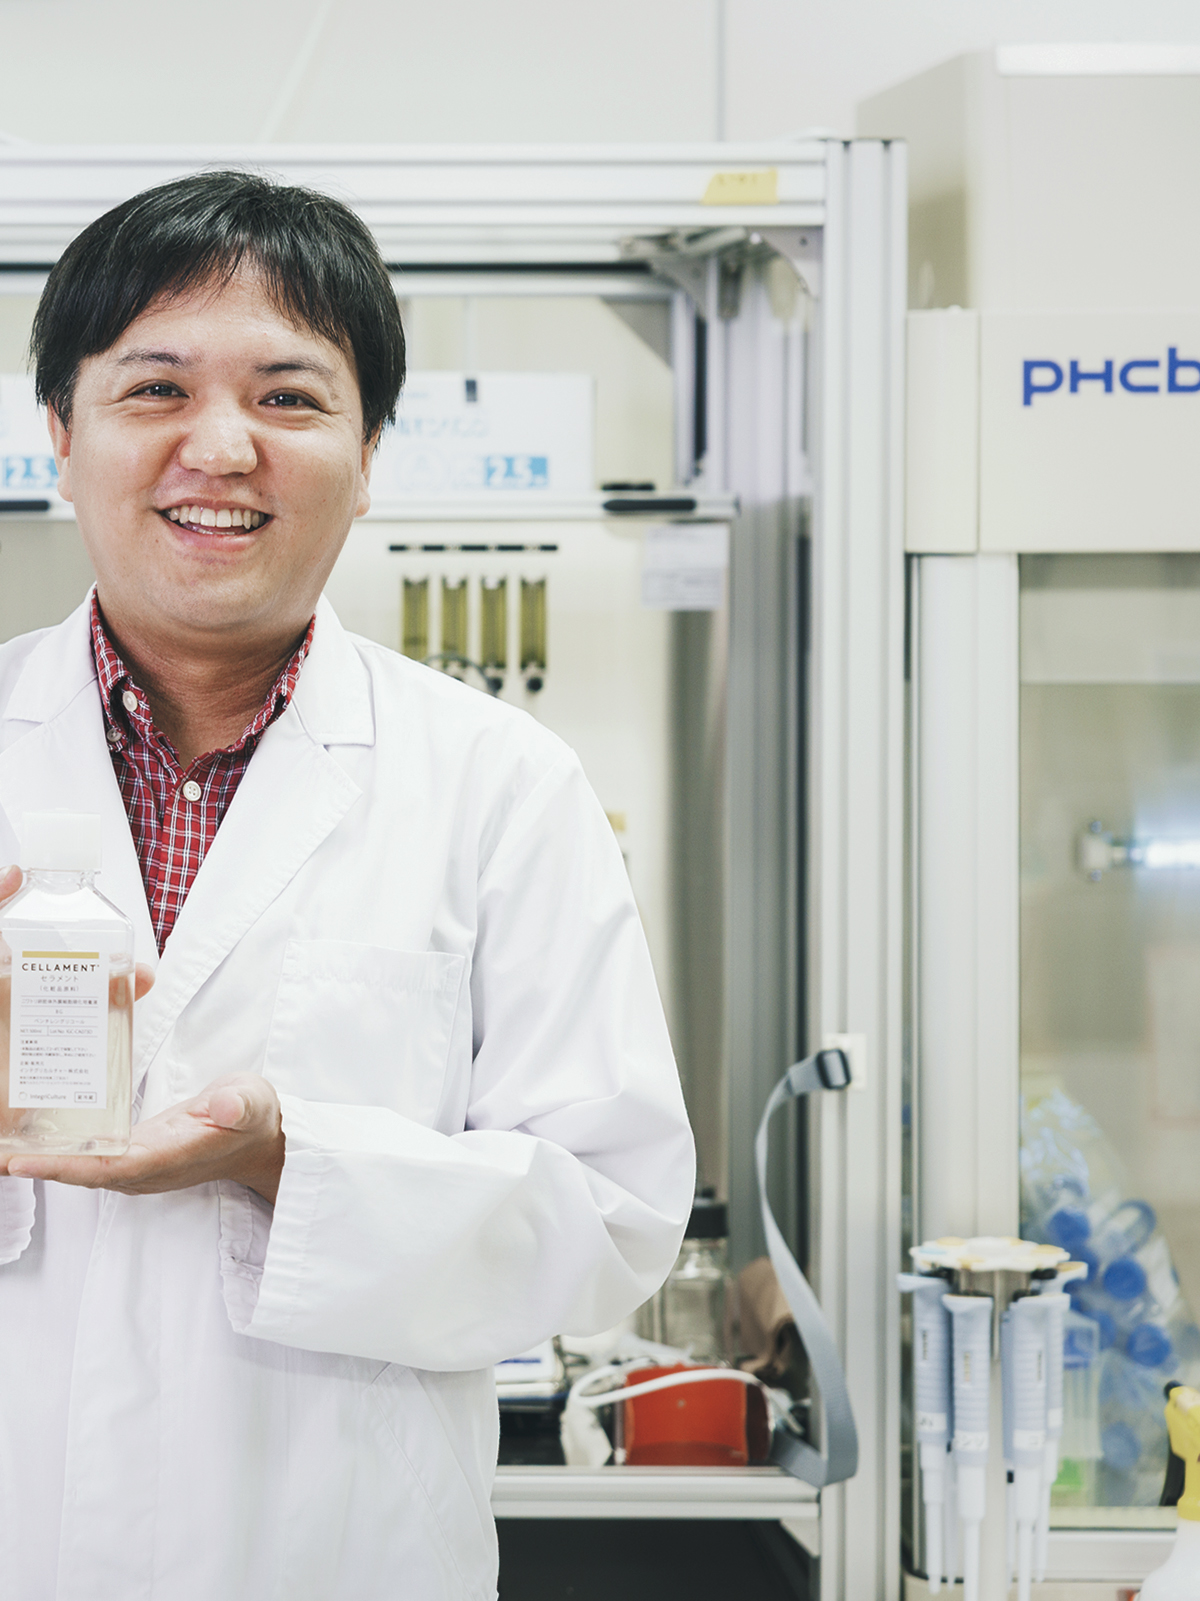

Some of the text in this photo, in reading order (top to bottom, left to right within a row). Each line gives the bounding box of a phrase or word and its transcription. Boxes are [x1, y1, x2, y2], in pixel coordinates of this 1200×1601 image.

[22, 963, 97, 972] CELLAMENT
[41, 975, 79, 983] セラメント
